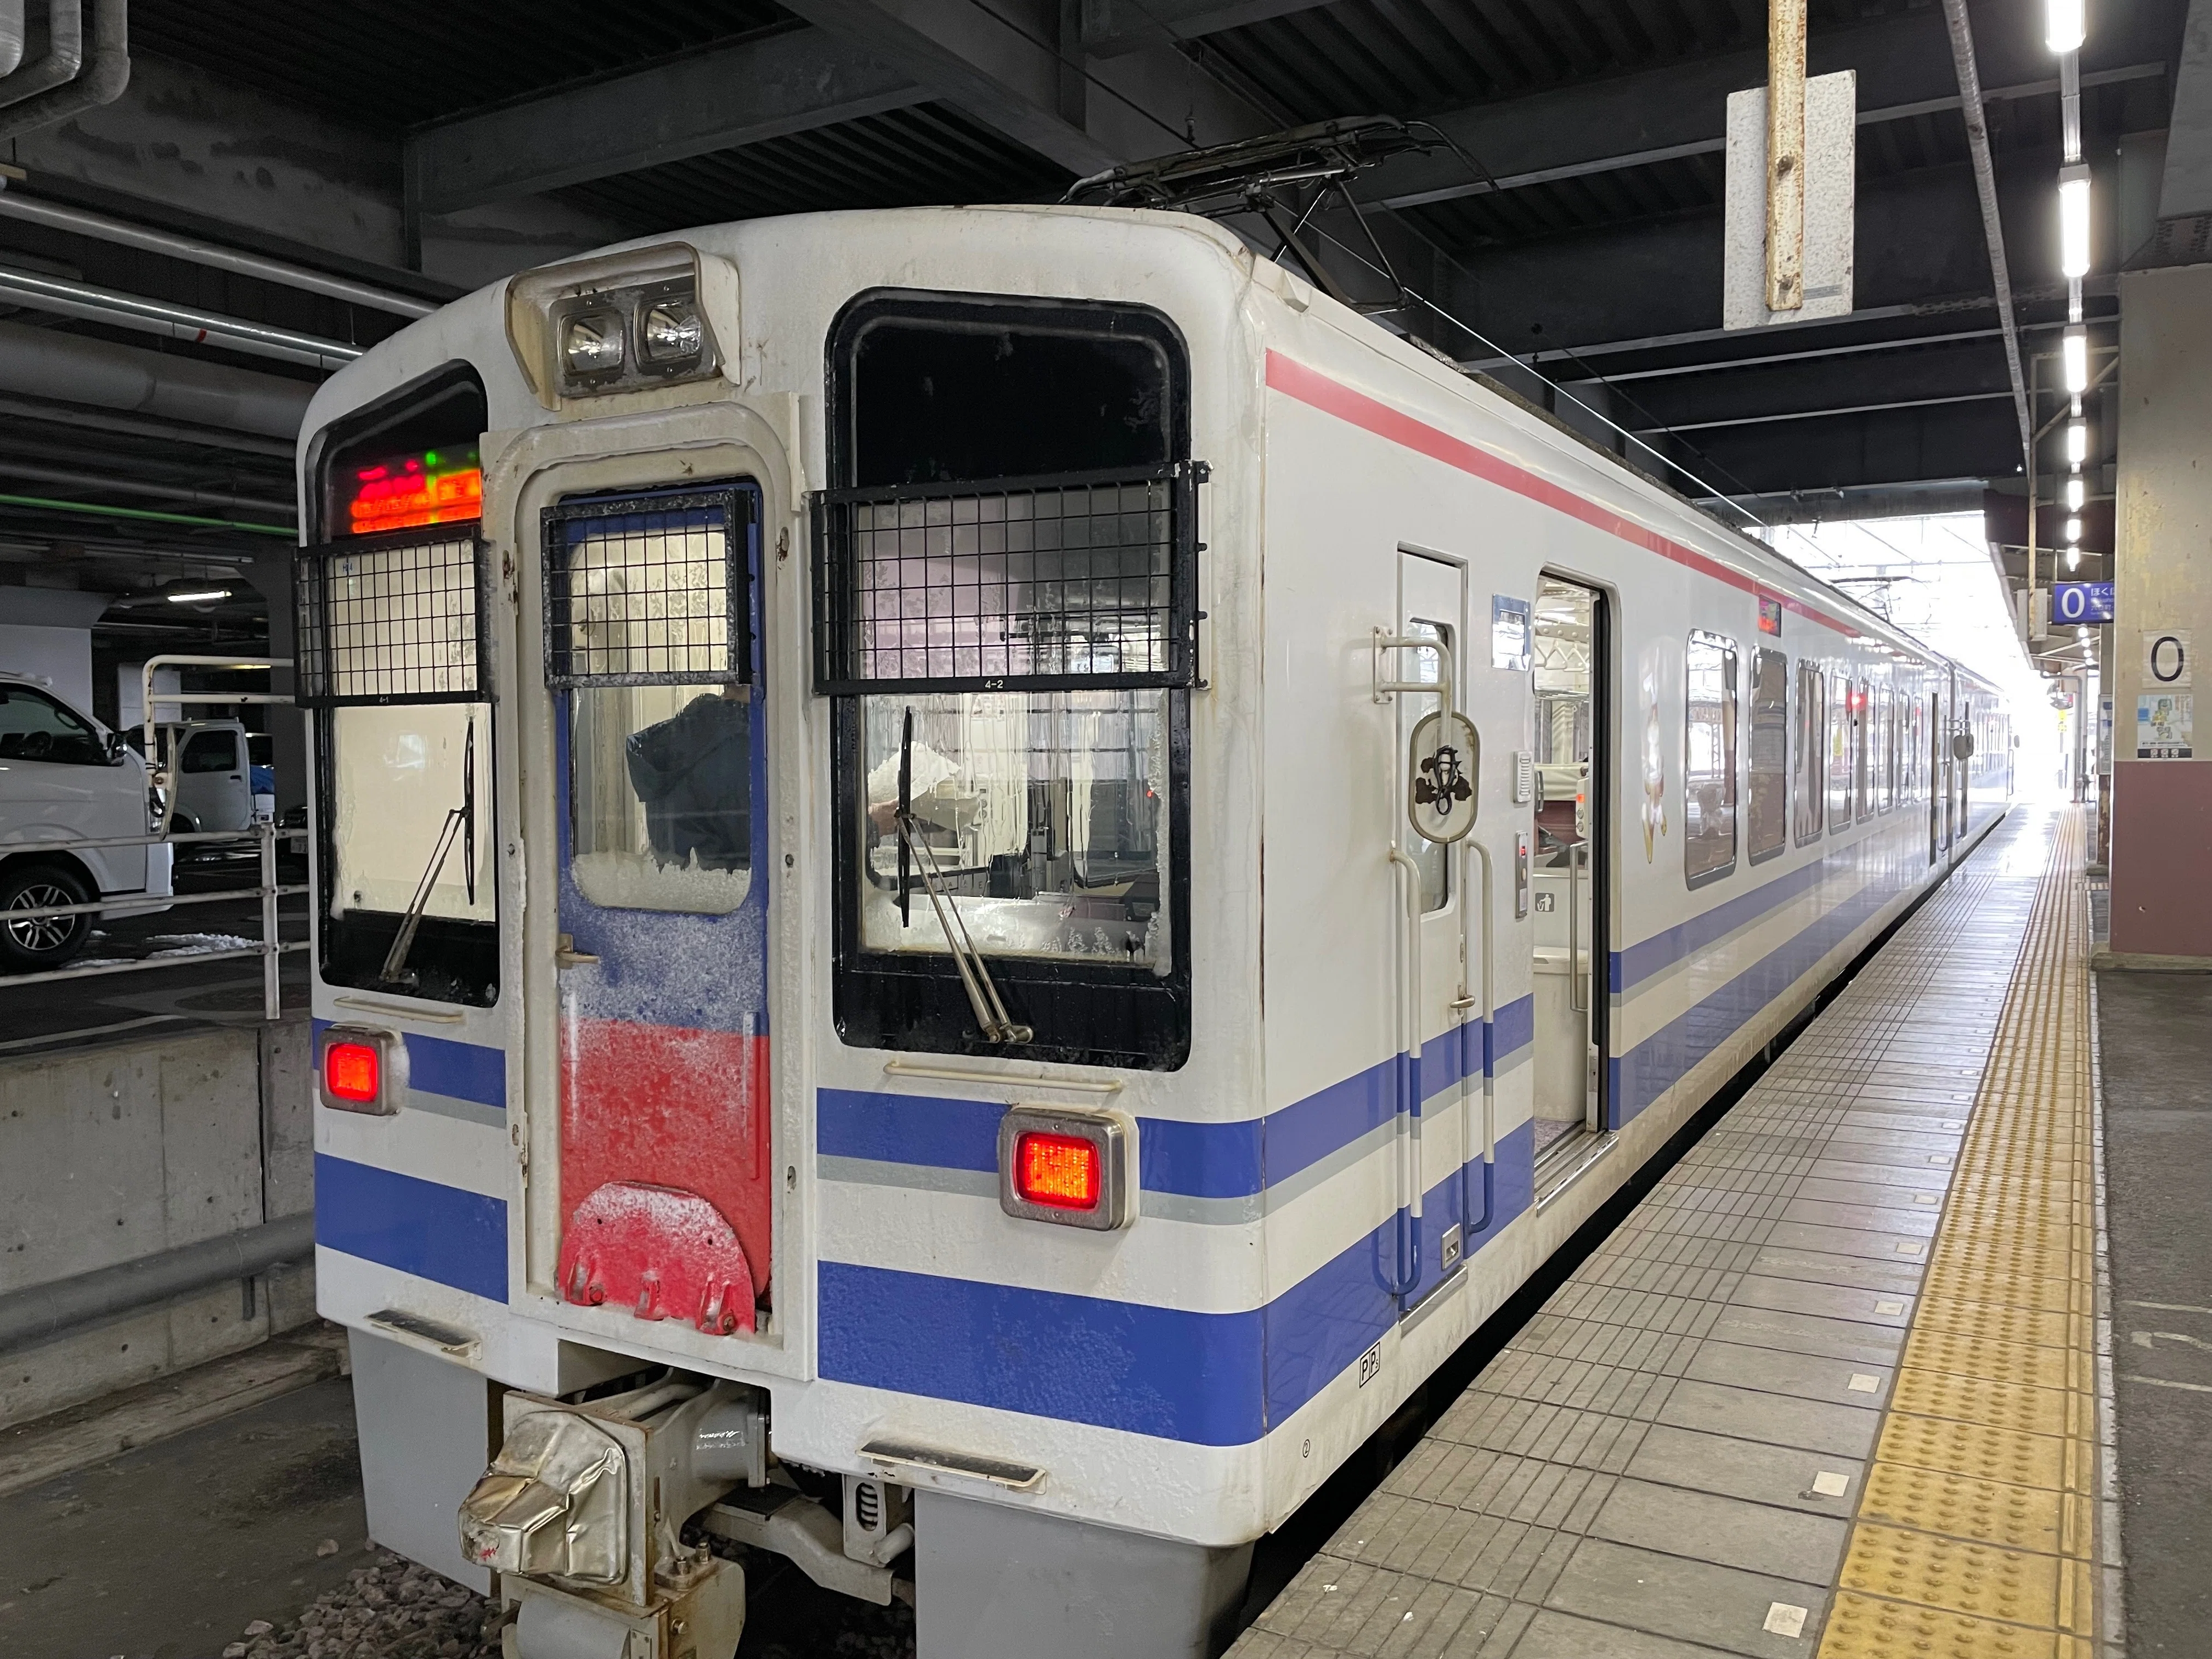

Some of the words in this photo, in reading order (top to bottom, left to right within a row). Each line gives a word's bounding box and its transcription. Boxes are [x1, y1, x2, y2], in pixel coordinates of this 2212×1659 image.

[2061, 588, 2085, 618] 0
[2151, 636, 2184, 681] 0
[985, 680, 1003, 689] 4-2
